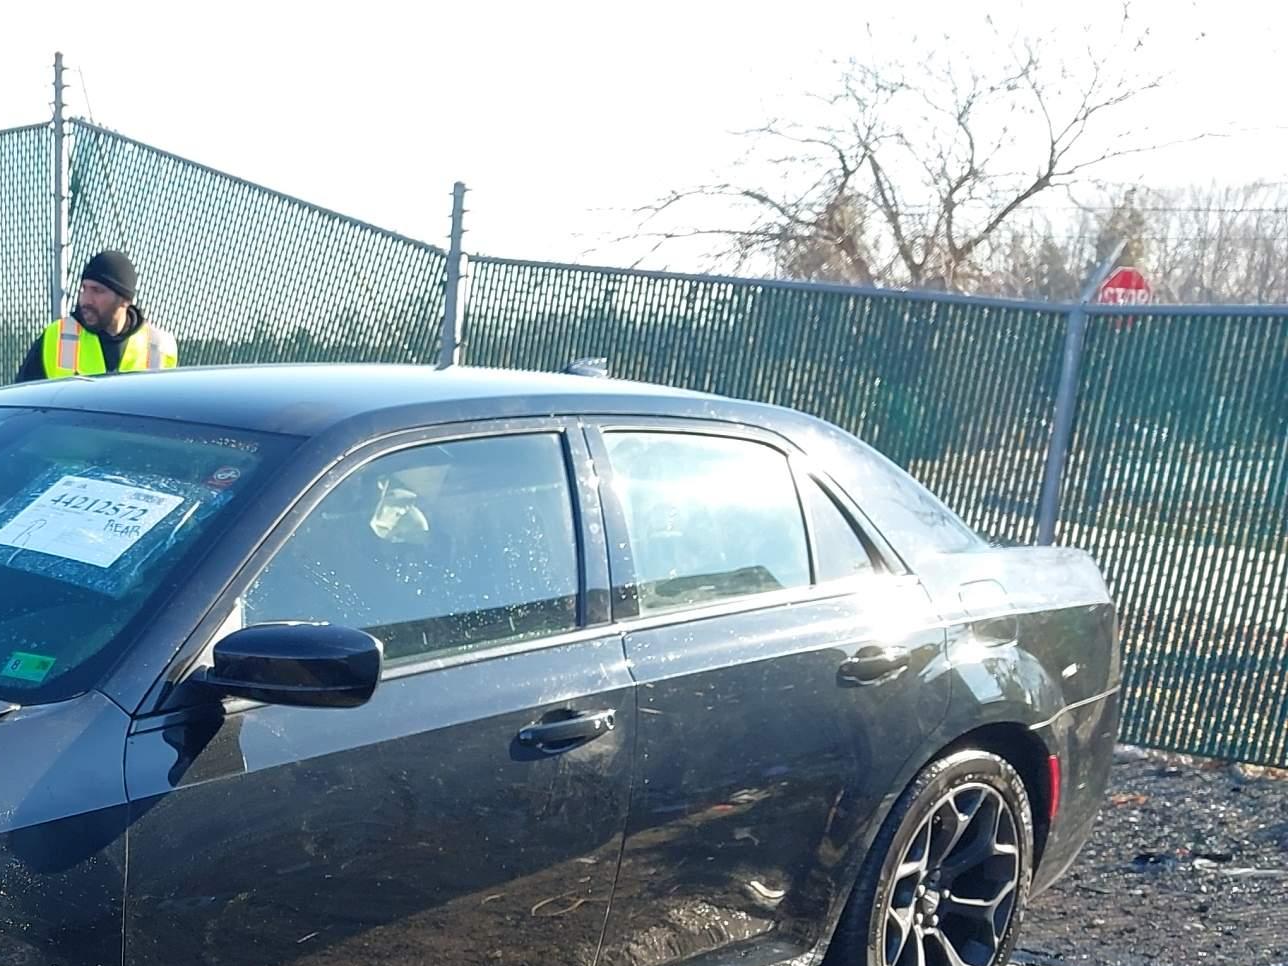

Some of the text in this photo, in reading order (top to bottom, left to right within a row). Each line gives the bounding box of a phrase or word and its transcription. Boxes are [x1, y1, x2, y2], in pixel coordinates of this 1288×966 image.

[1103, 286, 1149, 304] STOP
[50, 493, 148, 521] 44212572
[103, 519, 141, 538] REAR
